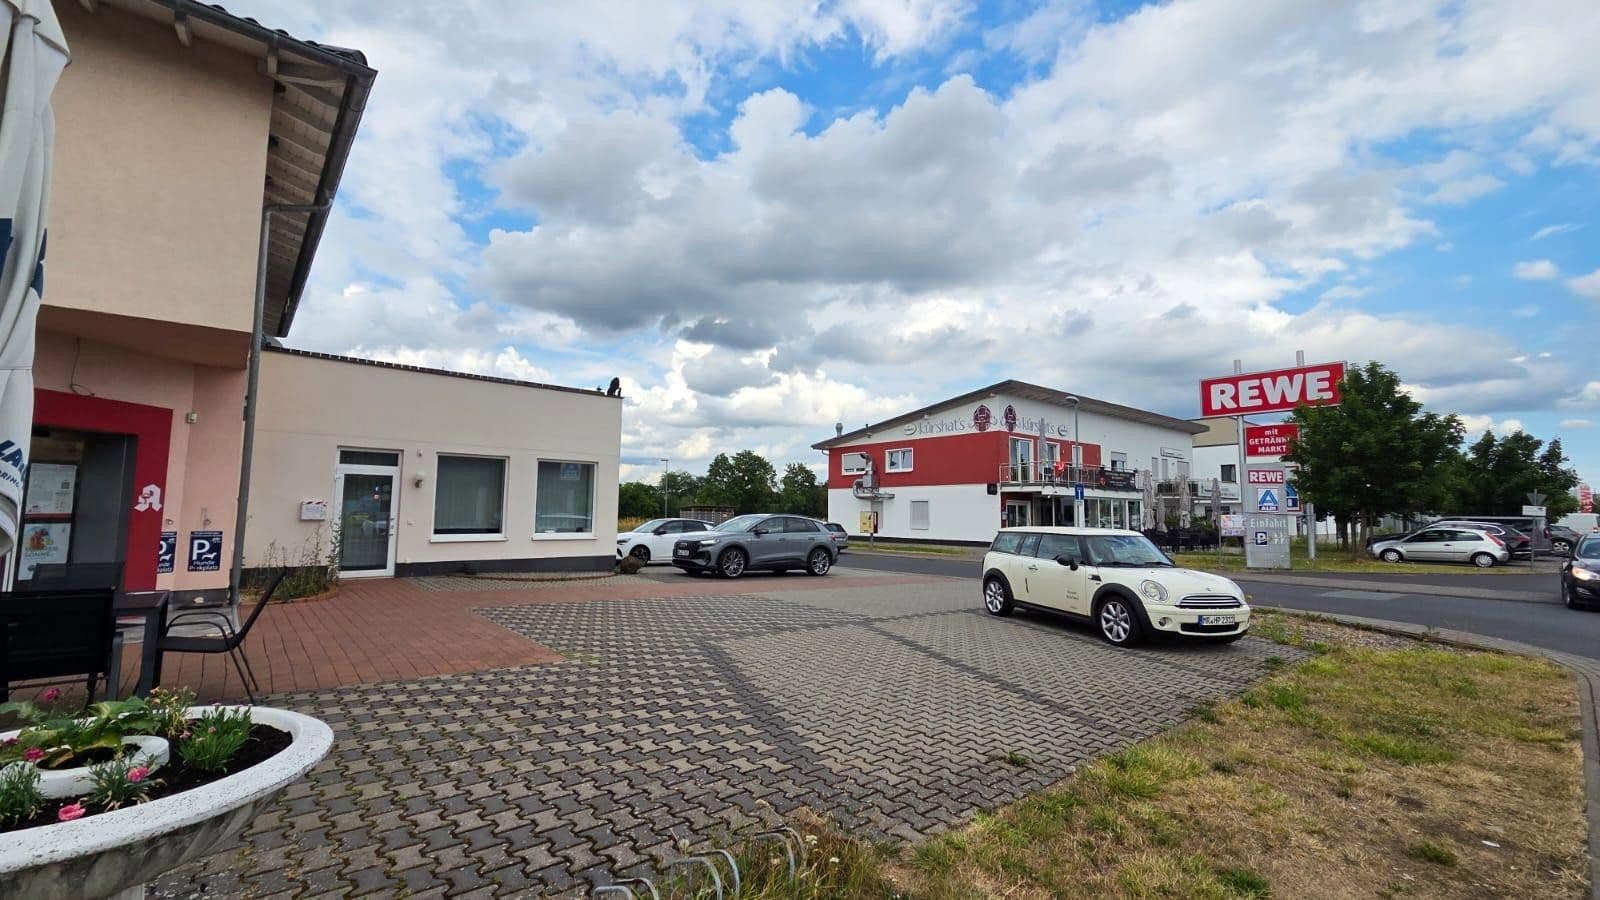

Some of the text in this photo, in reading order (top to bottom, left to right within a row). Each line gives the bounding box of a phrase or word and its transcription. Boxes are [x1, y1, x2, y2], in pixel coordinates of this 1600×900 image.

[1210, 371, 1333, 410] REWE
[1264, 428, 1278, 436] mit
[1249, 435, 1289, 446] GETRÄNK
[1257, 445, 1286, 453] MARKT
[1249, 471, 1283, 482] REWE
[1250, 518, 1287, 528] Einfahrt
[192, 540, 210, 560] P
